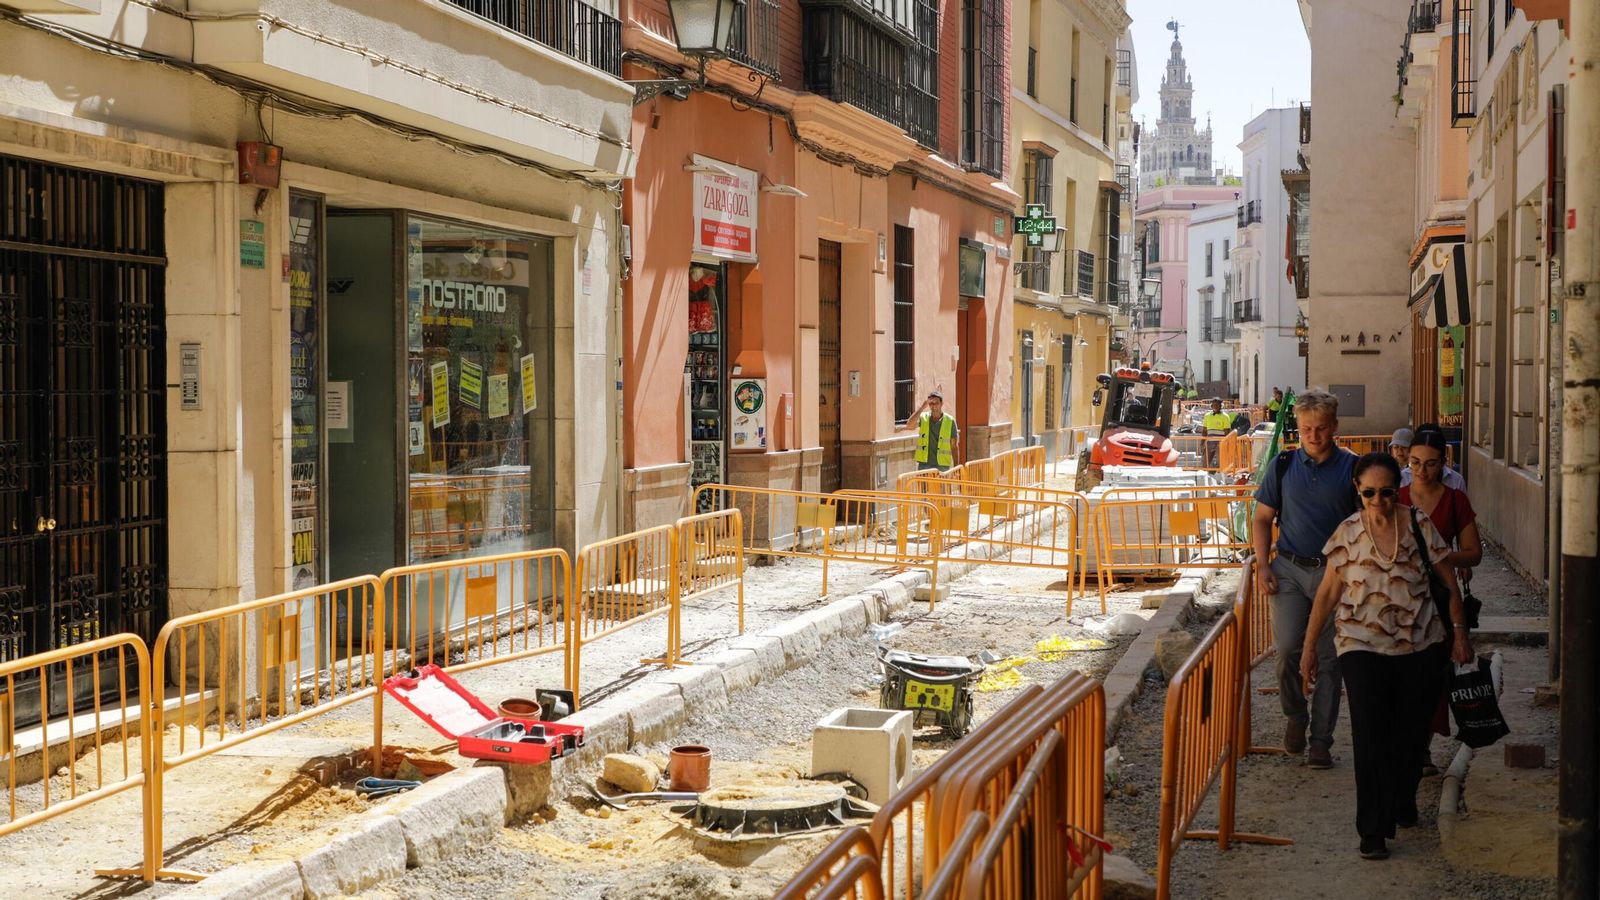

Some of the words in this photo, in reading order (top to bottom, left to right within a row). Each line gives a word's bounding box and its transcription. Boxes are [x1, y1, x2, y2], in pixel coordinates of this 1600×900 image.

[704, 185, 750, 220] ZARAGOZA
[1018, 219, 1054, 232] 12:44
[422, 278, 507, 313] NOSTROMO
[1325, 331, 1397, 347] AMARA
[291, 463, 313, 481] MPRO
